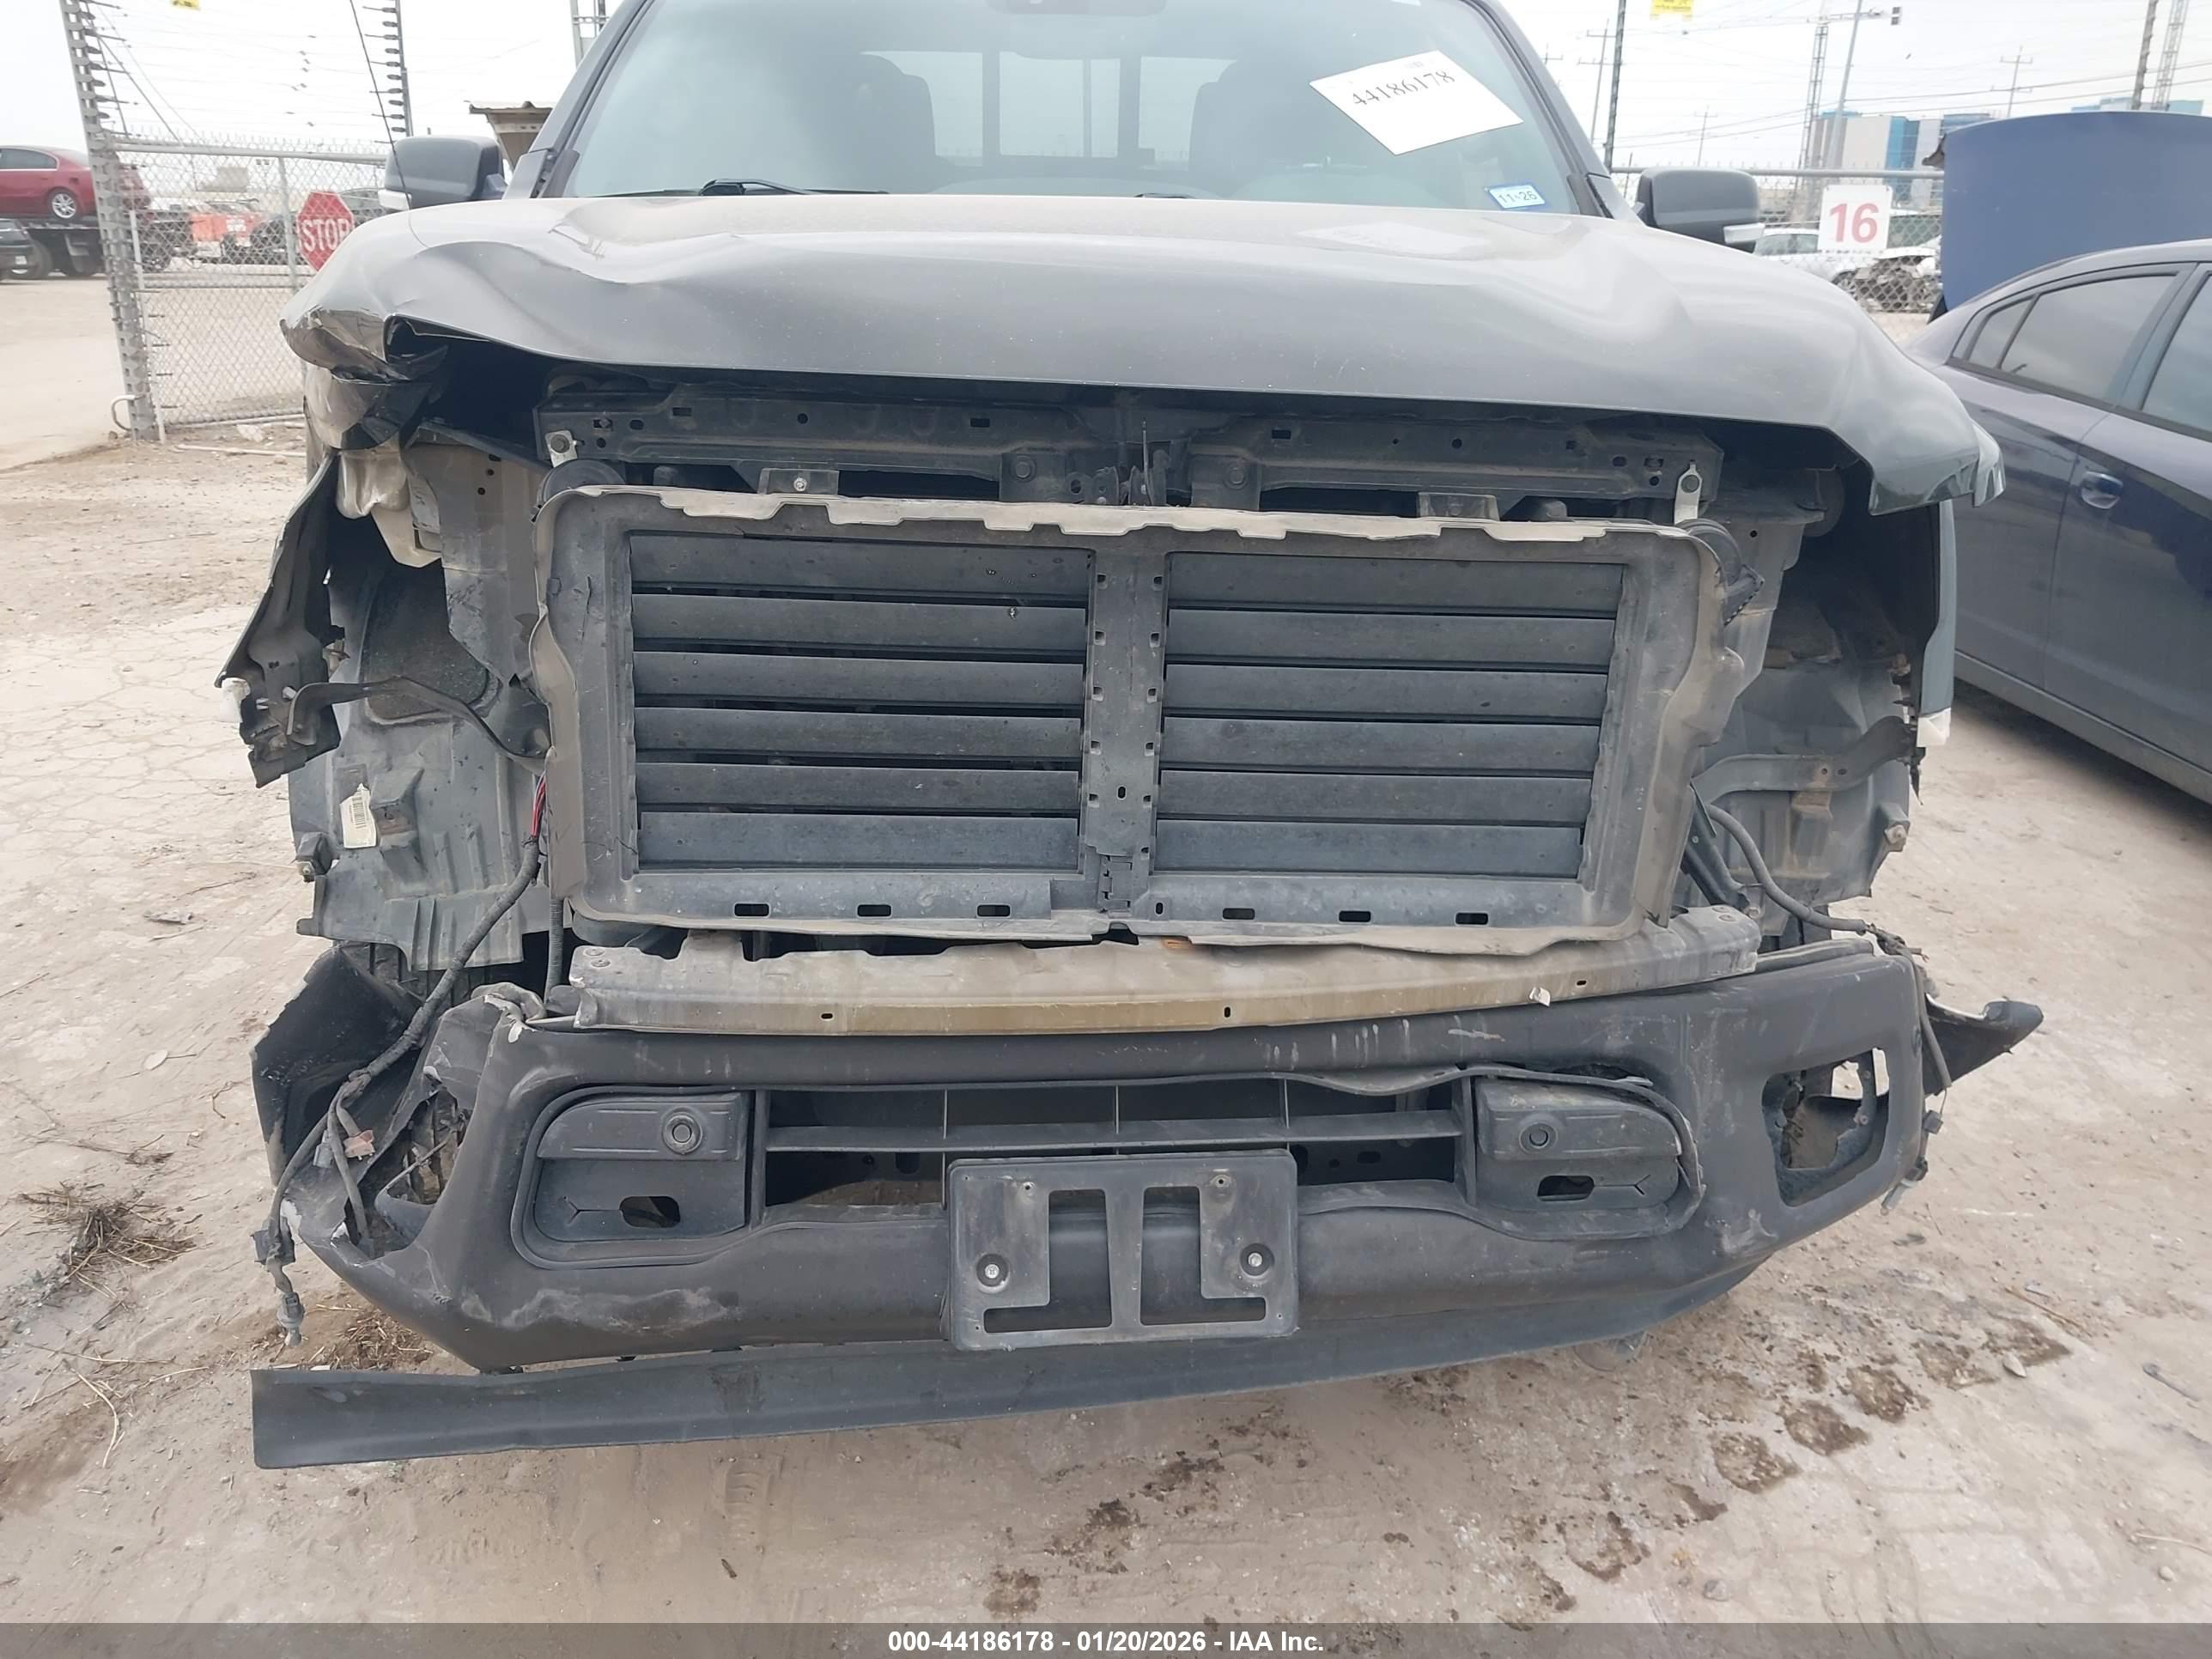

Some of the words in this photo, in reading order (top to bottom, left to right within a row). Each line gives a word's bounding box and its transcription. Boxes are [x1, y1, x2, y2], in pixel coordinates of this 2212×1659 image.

[1352, 70, 1455, 106] 44186178
[301, 217, 349, 252] STOP
[1829, 203, 1879, 243] 16
